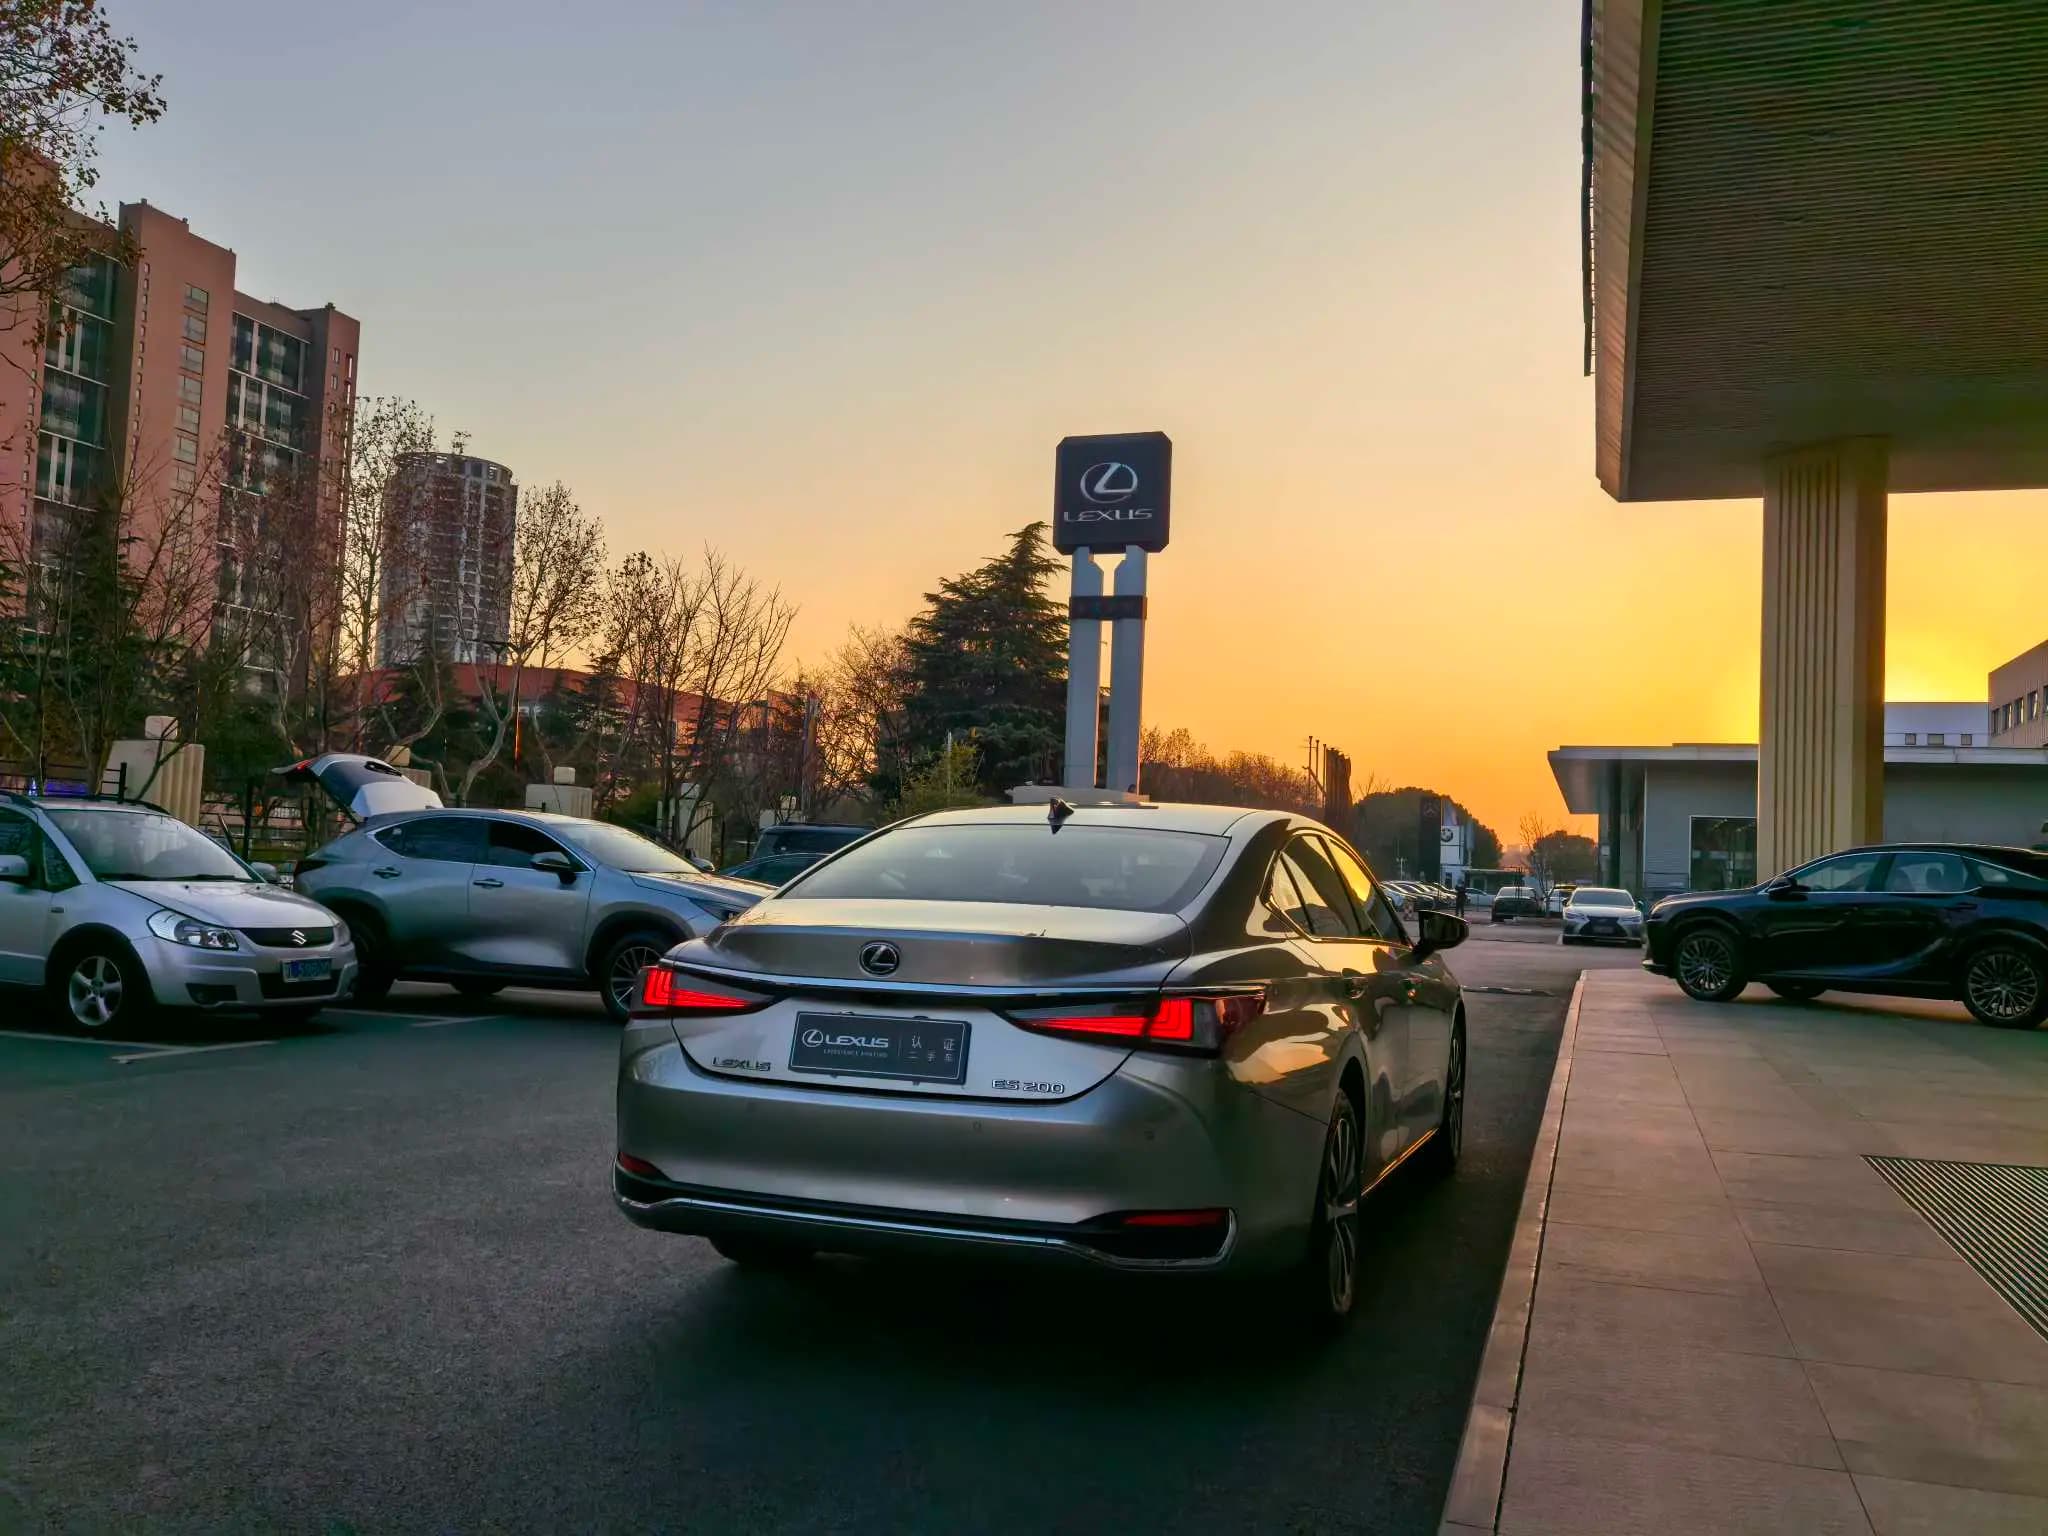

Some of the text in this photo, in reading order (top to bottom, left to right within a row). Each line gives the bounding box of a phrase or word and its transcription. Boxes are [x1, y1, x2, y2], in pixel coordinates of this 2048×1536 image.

[1063, 508, 1152, 522] LEXUS
[825, 1034, 889, 1048] LEXUS
[712, 1056, 771, 1072] LEXUS
[992, 1079, 1065, 1095] ES 200
